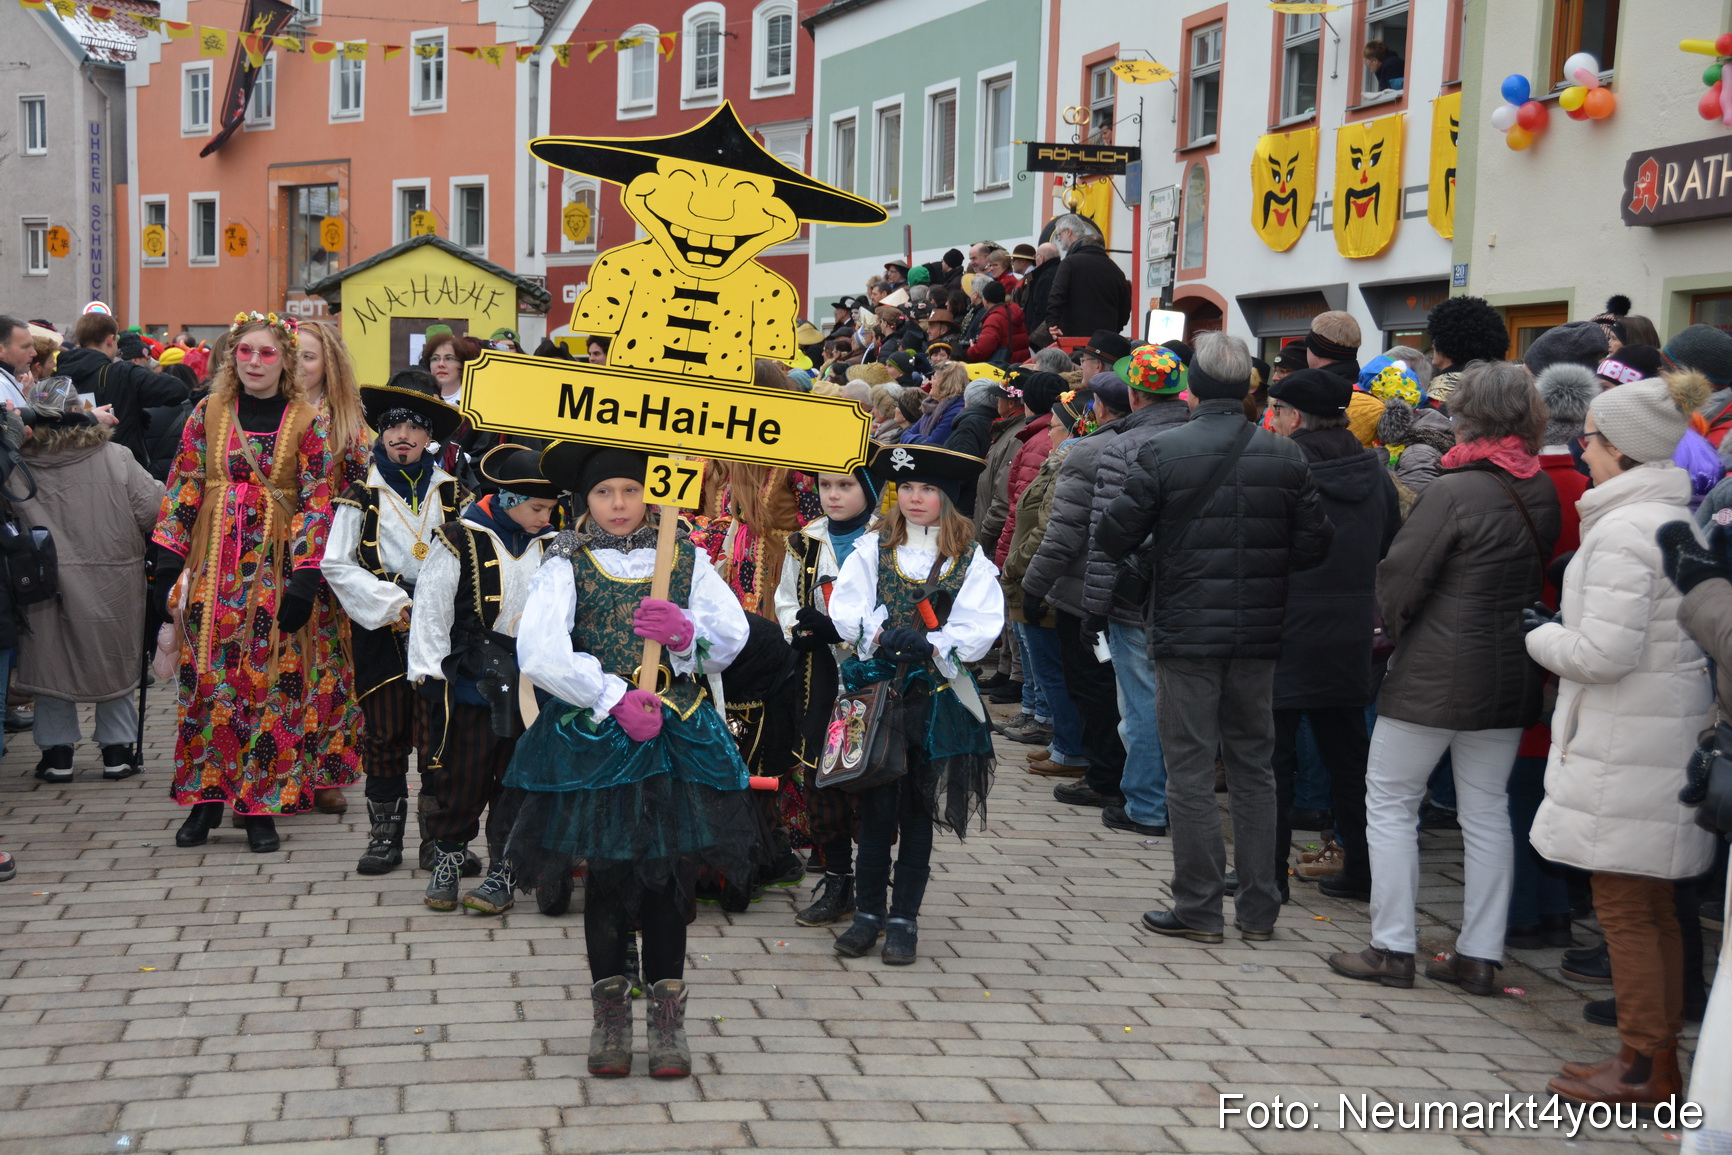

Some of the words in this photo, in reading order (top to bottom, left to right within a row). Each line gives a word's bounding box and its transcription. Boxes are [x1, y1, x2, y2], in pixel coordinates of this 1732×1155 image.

[90, 122, 101, 194] UHREN
[1038, 147, 1129, 163] RÖHLICH
[90, 204, 102, 301] SCHMUCK
[1455, 265, 1466, 277] 20
[286, 298, 330, 317] GÖT
[557, 383, 782, 446] Ma-Hai-He
[648, 464, 698, 501] 37
